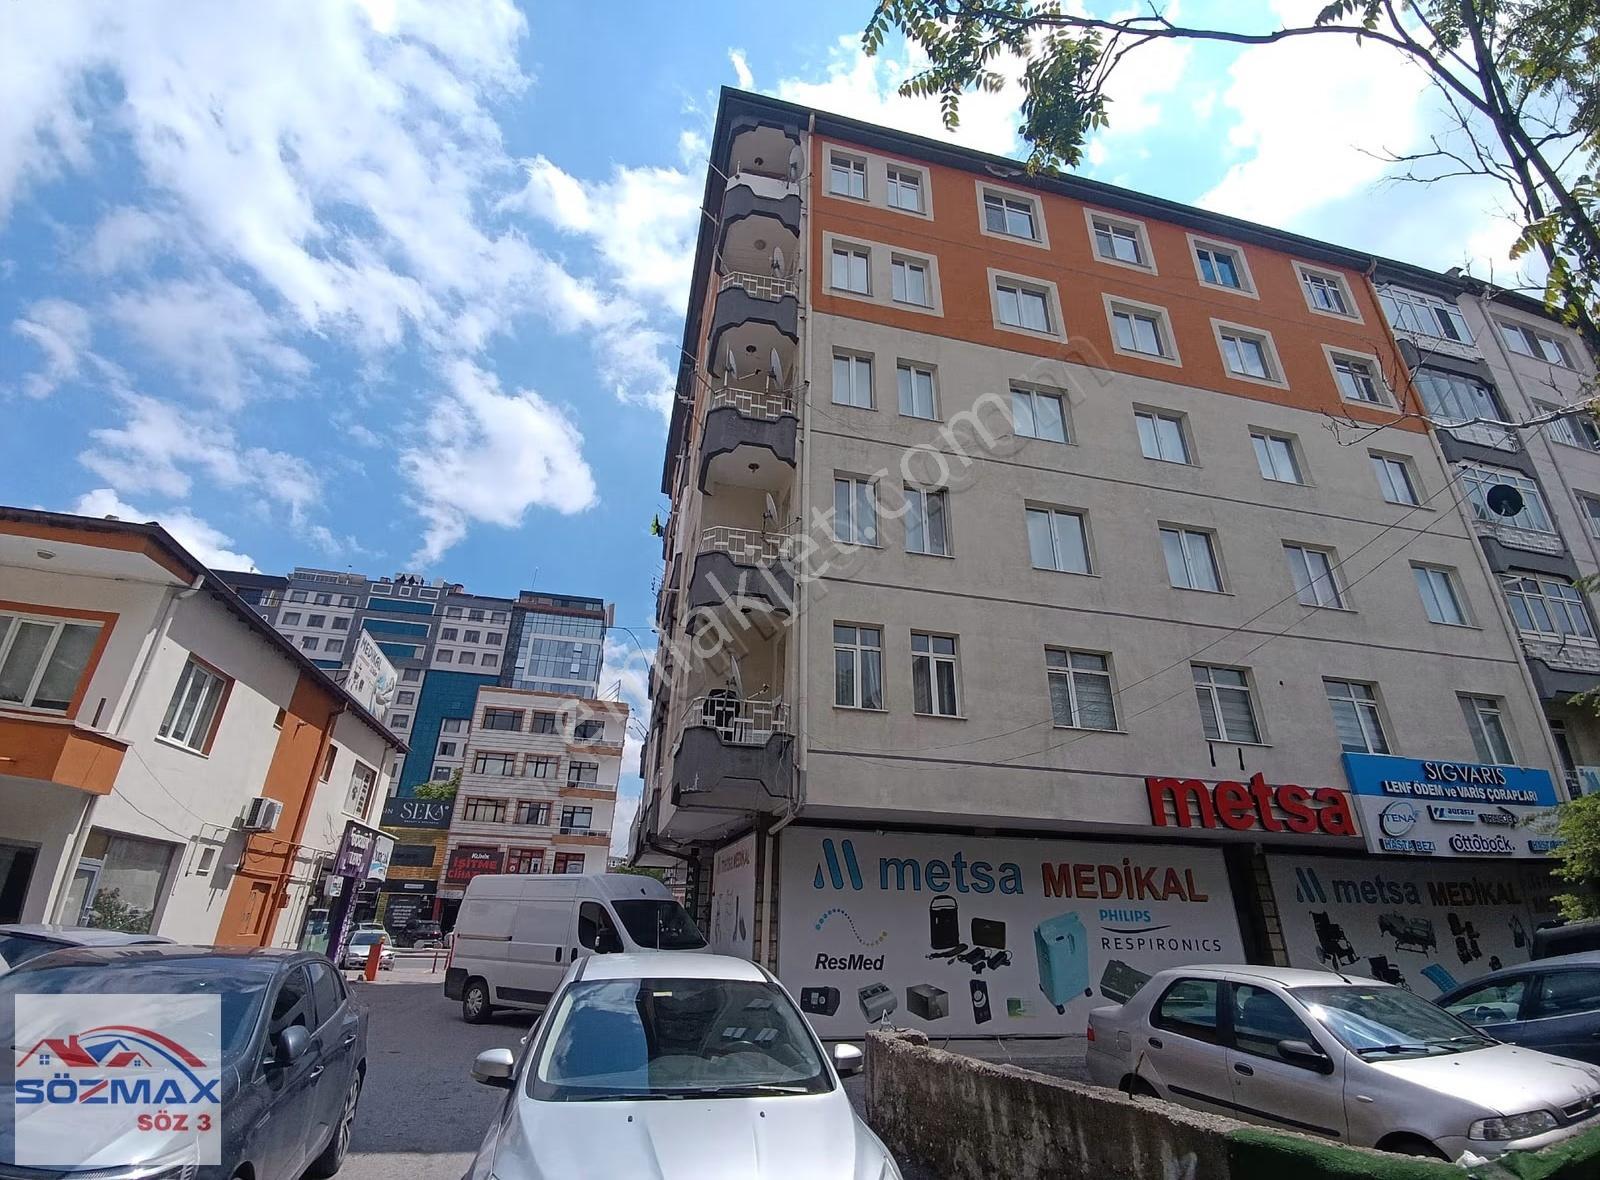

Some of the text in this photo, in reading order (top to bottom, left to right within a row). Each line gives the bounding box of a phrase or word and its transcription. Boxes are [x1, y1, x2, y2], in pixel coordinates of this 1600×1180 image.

[1425, 762, 1507, 785] SIGVARIS
[1384, 780, 1412, 794] LENF
[1413, 780, 1444, 797] ÖDEM
[1444, 788, 1457, 797] ve
[1457, 784, 1486, 799] VARİS
[1144, 772, 1356, 836] metsa
[1382, 813, 1417, 823] TENA
[1384, 839, 1414, 851] HASTA
[879, 851, 1209, 902] metsa MEDİKAL
[1332, 874, 1421, 905] metsa
[1426, 877, 1522, 906] MEDİKAL
[1099, 908, 1151, 923] PHILIPS
[1101, 937, 1222, 952] RESPIRONICS
[815, 953, 885, 971] ResMed
